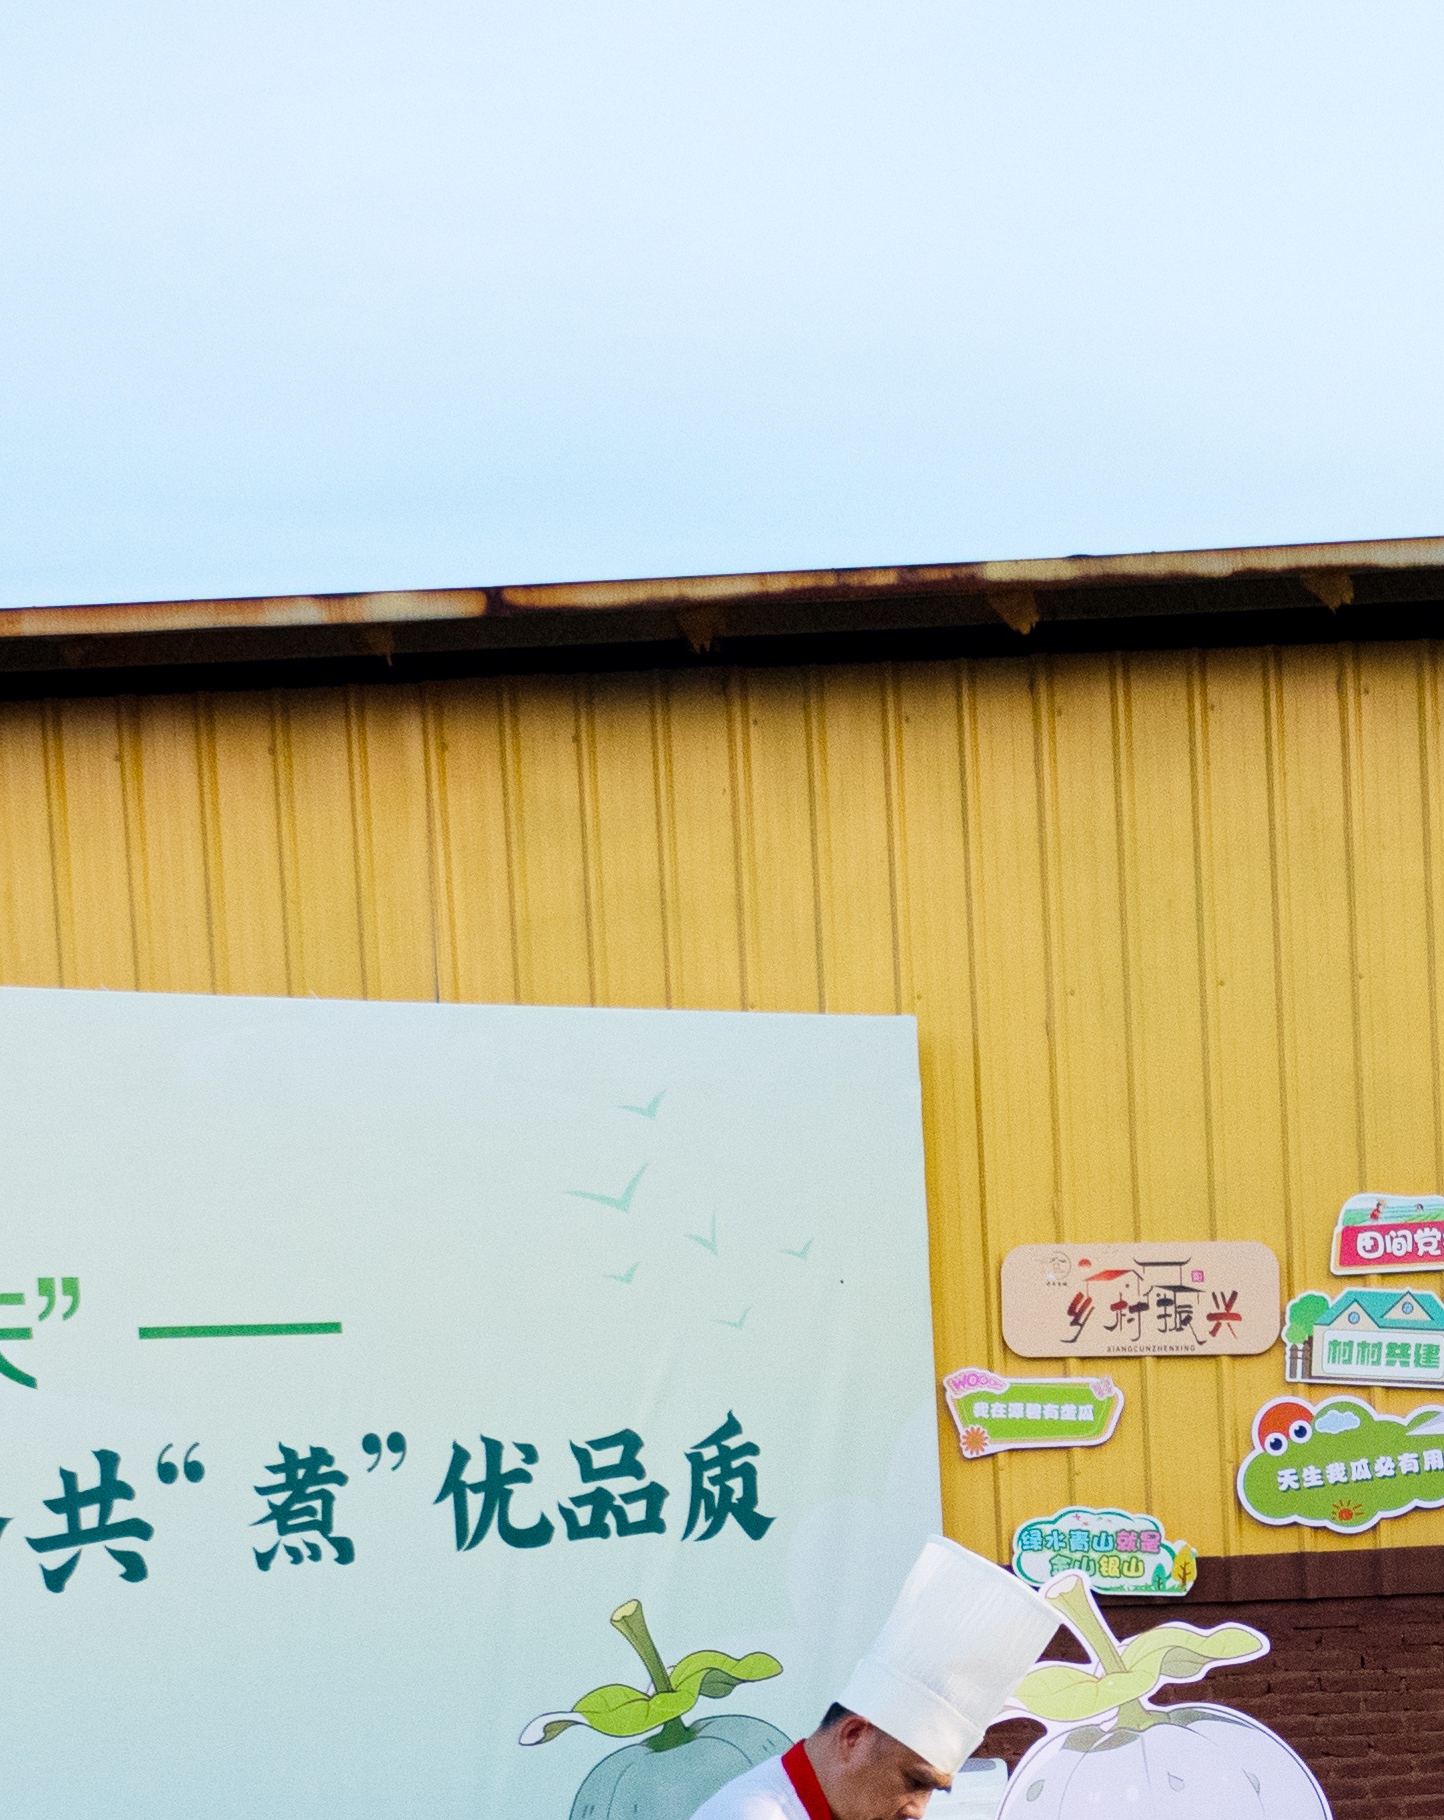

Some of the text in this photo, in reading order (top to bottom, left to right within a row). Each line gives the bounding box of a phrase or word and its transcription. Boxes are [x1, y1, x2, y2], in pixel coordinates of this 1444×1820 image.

[1060, 1289, 1243, 1345] 乡村振兴
[1327, 1339, 1441, 1368] 村村共建
[1020, 1529, 1162, 1554] 绿水青山就是
